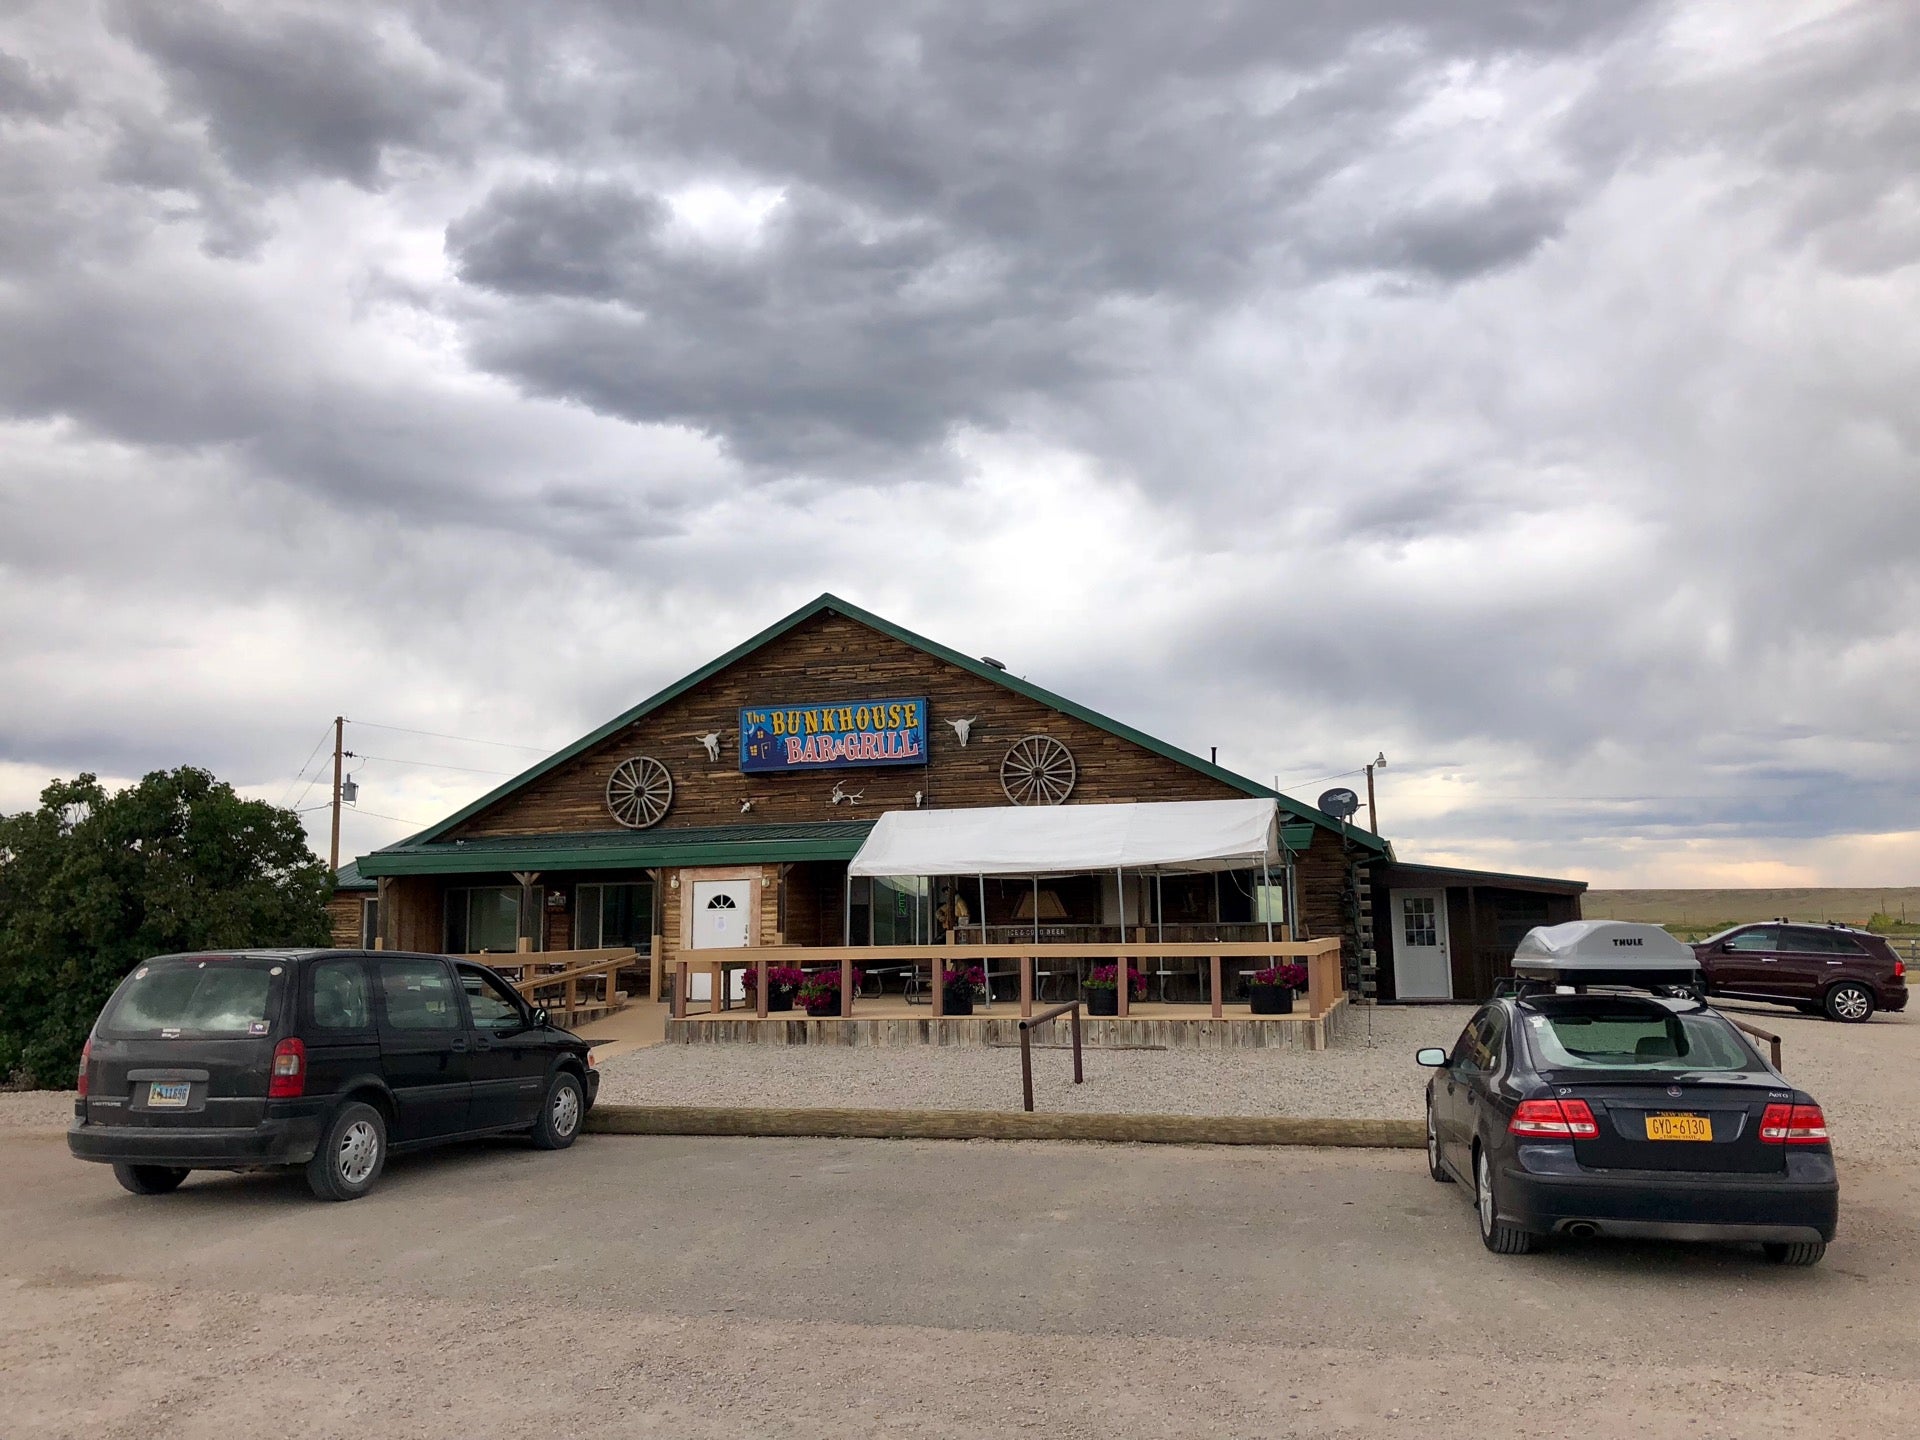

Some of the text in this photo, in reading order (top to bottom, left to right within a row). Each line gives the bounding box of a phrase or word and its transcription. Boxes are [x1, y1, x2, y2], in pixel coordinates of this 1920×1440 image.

[746, 704, 918, 735] The BUNKHOUSE
[1612, 938, 1644, 946] THULE
